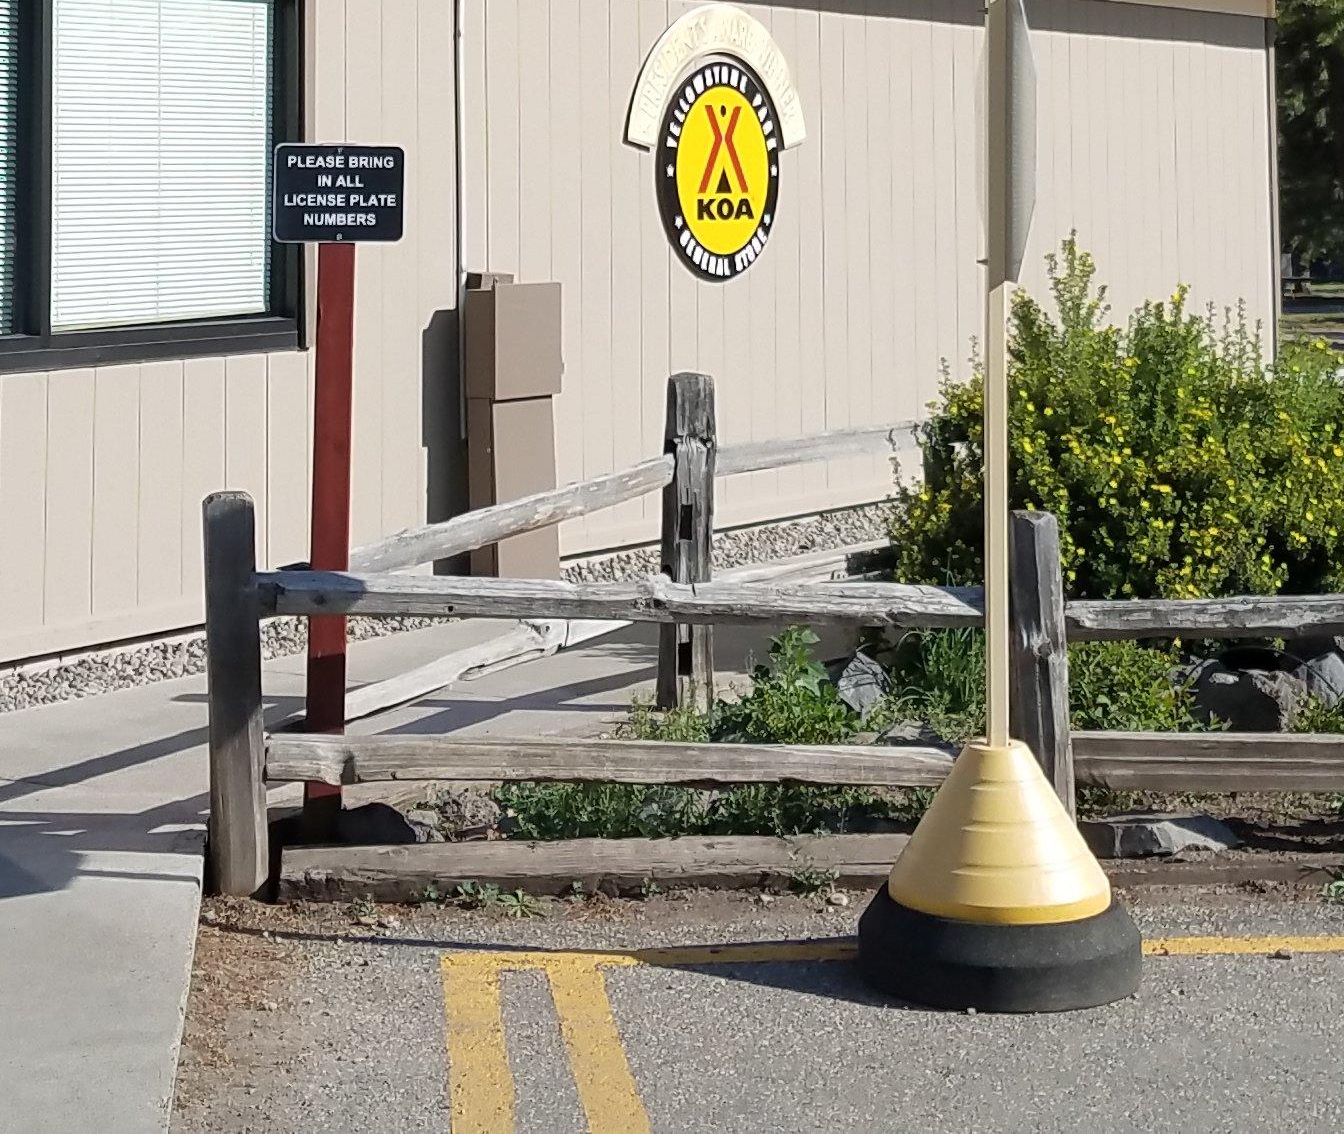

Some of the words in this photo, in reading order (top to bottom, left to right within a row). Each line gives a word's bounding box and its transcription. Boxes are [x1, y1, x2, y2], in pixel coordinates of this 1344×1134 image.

[666, 65, 748, 148] YELLOWSTONE
[752, 92, 777, 151] PARK
[287, 155, 346, 168] PLEASE
[348, 156, 395, 168] BRING
[317, 175, 333, 187] IN
[335, 175, 365, 187] ALL
[283, 194, 346, 207] LICENSE
[349, 194, 397, 207] PLATE
[696, 198, 755, 221] KOA
[303, 213, 376, 226] NUMBERS
[679, 229, 731, 277] GENERAL
[734, 227, 768, 272] STORE
